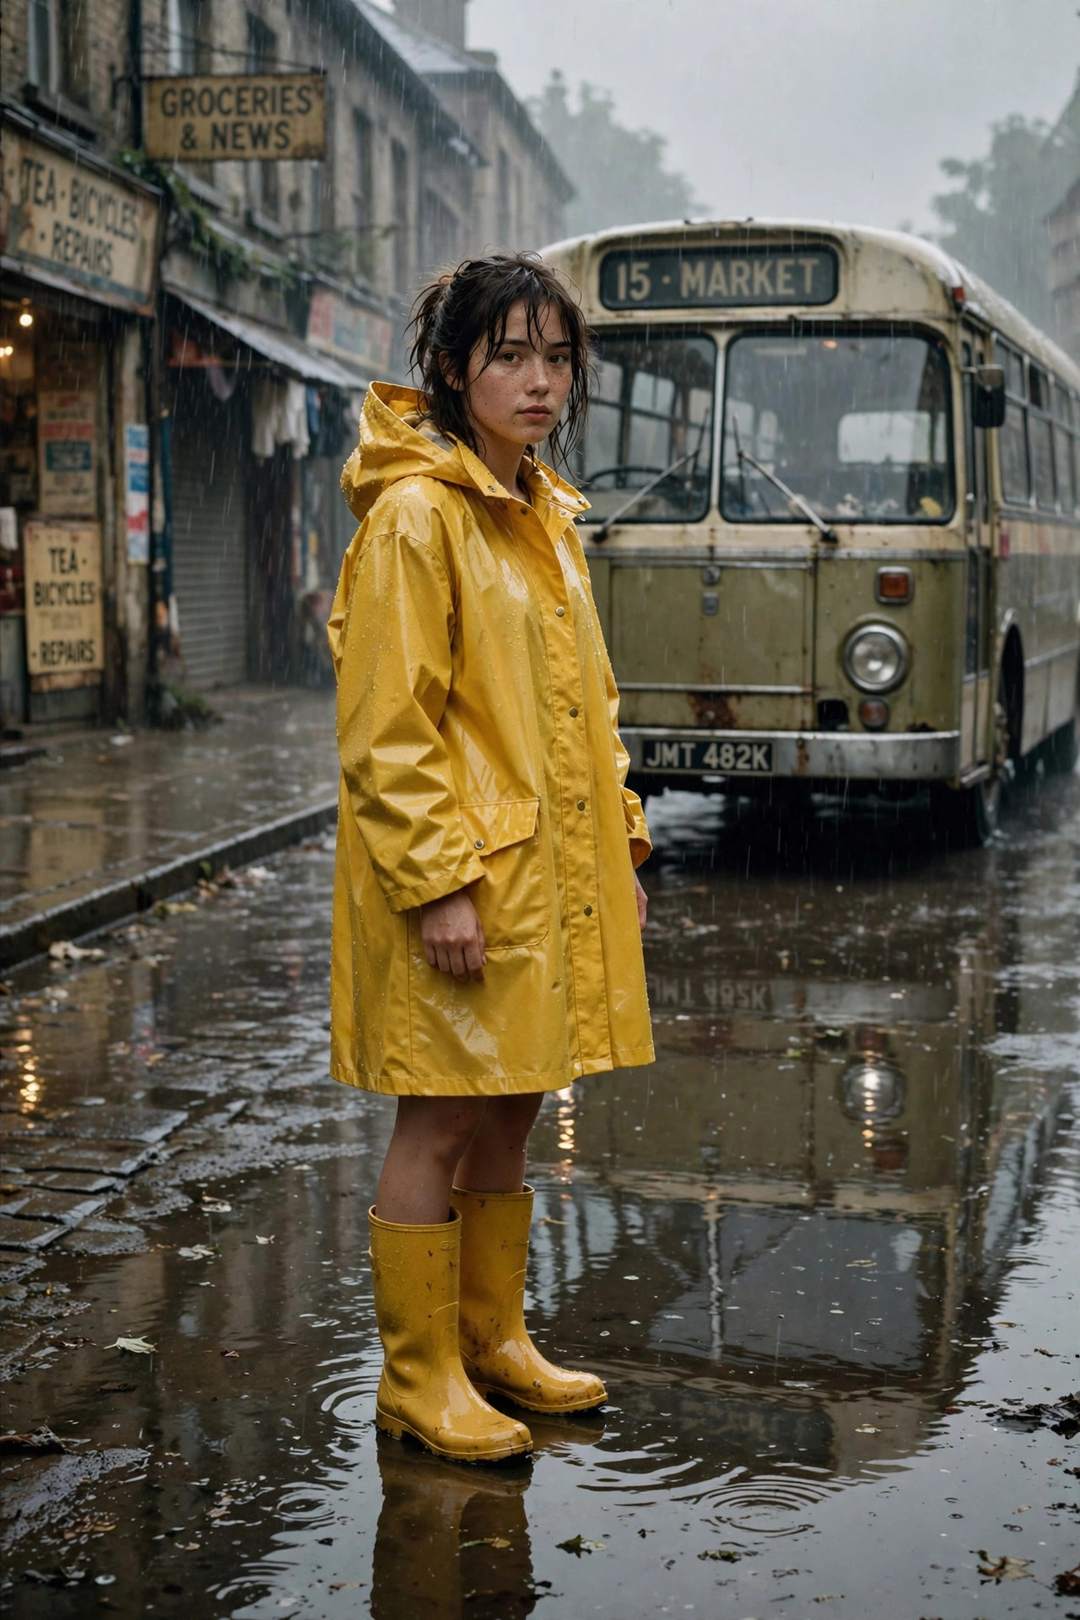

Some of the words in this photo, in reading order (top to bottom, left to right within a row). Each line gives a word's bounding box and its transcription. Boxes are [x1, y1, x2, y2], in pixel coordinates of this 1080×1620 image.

[160, 84, 313, 117] GROCERIES
[180, 122, 197, 150] &
[210, 121, 291, 150] NEWS
[51, 221, 114, 277] REPAIRS
[617, 261, 650, 300] 15
[680, 258, 819, 298] MARKET
[48, 547, 79, 574] TEA
[33, 581, 96, 607] BICYCLES
[40, 639, 96, 665] REPAIRS
[646, 742, 696, 768] JMT
[703, 743, 769, 770] 482K
